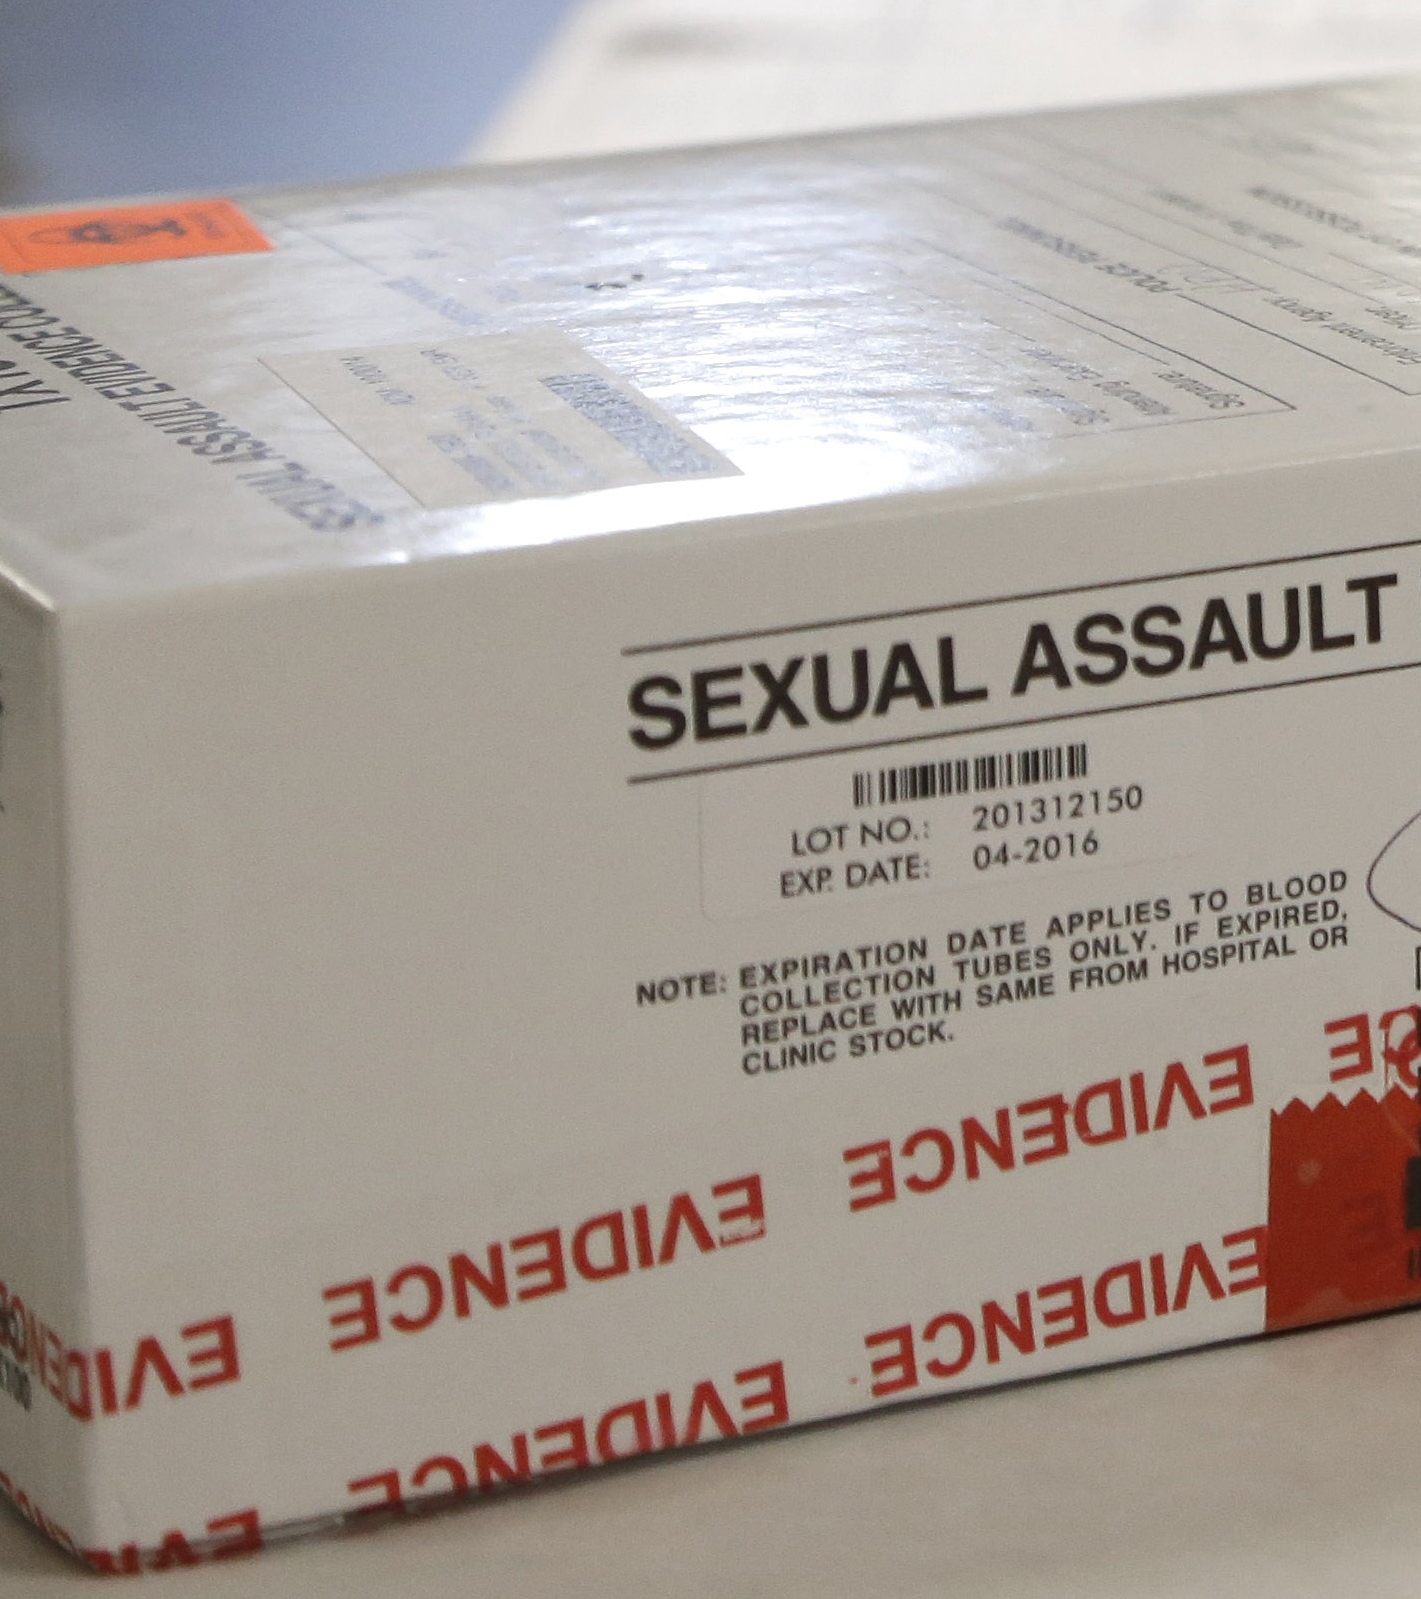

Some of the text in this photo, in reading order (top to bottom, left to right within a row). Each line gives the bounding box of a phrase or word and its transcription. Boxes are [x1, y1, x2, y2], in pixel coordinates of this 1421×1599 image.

[8, 327, 177, 401] EVIDENCE
[118, 397, 284, 464] ASSAULT
[628, 636, 988, 751] SEXUAL
[1012, 573, 1397, 697] ASSAULT
[779, 829, 1100, 899] EXP. DATE: 04-2016
[792, 784, 1144, 857] LOT NO.: 201312150
[635, 869, 1348, 1007] NOTE: EXPIRATION DATE APPLIES TO BLOOD
[739, 899, 1349, 1018] COLLECTION TUBES ONLY. IF EXPIRED,
[741, 924, 1350, 1048] REPLACE WITH SAME FROM HOSPITAL OR
[741, 1019, 955, 1076] CLINIC STOCK.
[843, 1044, 1255, 1213] EVIDENCE
[322, 1174, 766, 1351] EVIDENCE
[864, 1224, 1269, 1398] EVIDENCE
